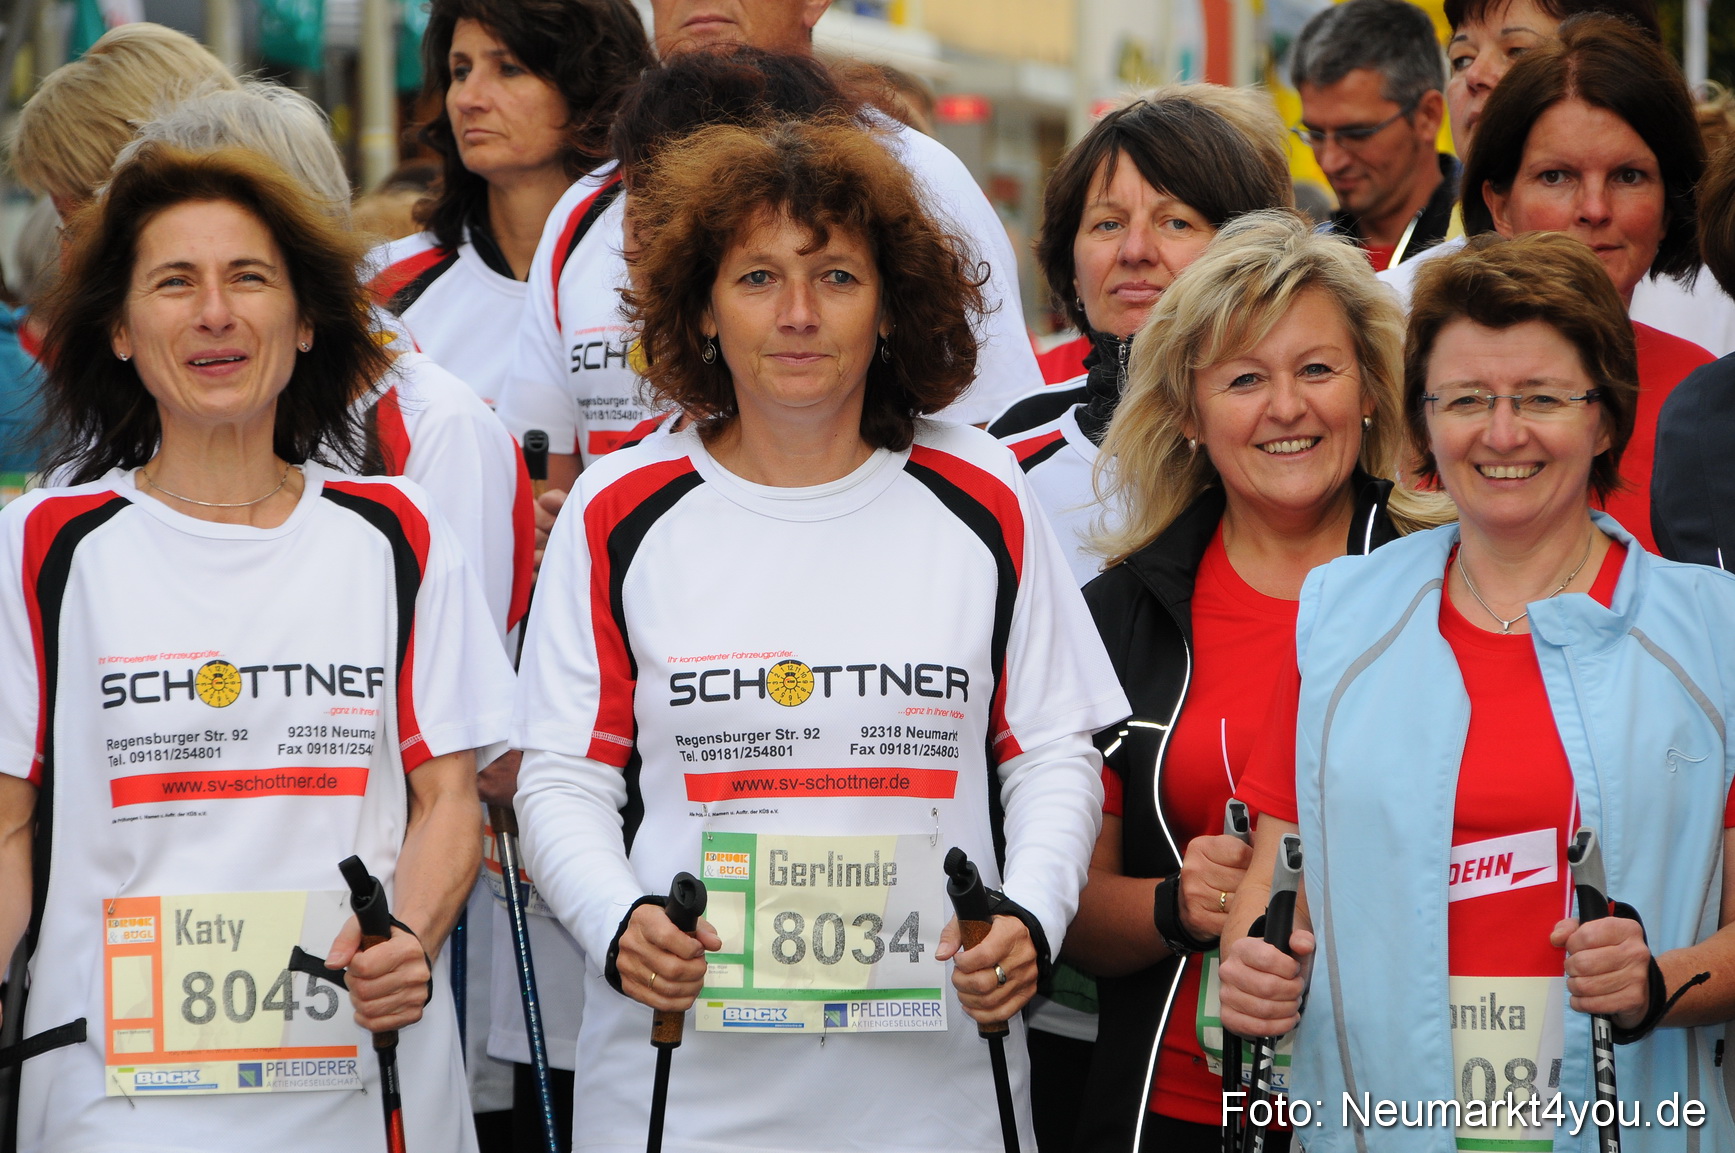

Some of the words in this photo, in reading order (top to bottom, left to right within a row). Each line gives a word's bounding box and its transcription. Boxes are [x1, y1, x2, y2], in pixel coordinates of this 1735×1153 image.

[107, 653, 158, 664] kompetenter
[678, 652, 730, 663] kompetenter
[669, 659, 970, 707] SCHOTTNER
[106, 733, 200, 751] Regensburger
[204, 730, 228, 742] Str.
[231, 729, 248, 741] 92
[288, 726, 327, 738] 92318
[675, 731, 771, 748] Regensburger
[775, 728, 799, 741] Str.
[803, 727, 820, 740] 92
[860, 726, 901, 739] 92318
[905, 726, 958, 742] Neumarkt
[108, 754, 126, 768] Tel.
[129, 747, 222, 763] 09181/254801
[278, 744, 303, 756] Fax
[307, 742, 374, 756] 09181/254
[680, 750, 698, 762] Tel.
[701, 745, 794, 761] 09181/254801
[850, 743, 875, 756] Fax
[879, 742, 959, 758] 09181/254803
[161, 774, 338, 795] www.sv-schottner.de
[732, 774, 910, 793] www.sv-schottner.de
[769, 849, 898, 887] Gerlinde
[174, 908, 245, 952] Katy
[771, 911, 925, 966] 8034
[181, 968, 339, 1025] 8045
[723, 1007, 788, 1022] BOCK
[851, 1001, 941, 1018] PFLEIDERER
[851, 1018, 943, 1028] AKTIENGESELLSCHAFT
[266, 1059, 357, 1077] PFLEIDERER
[134, 1070, 200, 1085] BOCK
[266, 1077, 361, 1088] AKTIENGESELLSCHAFT
